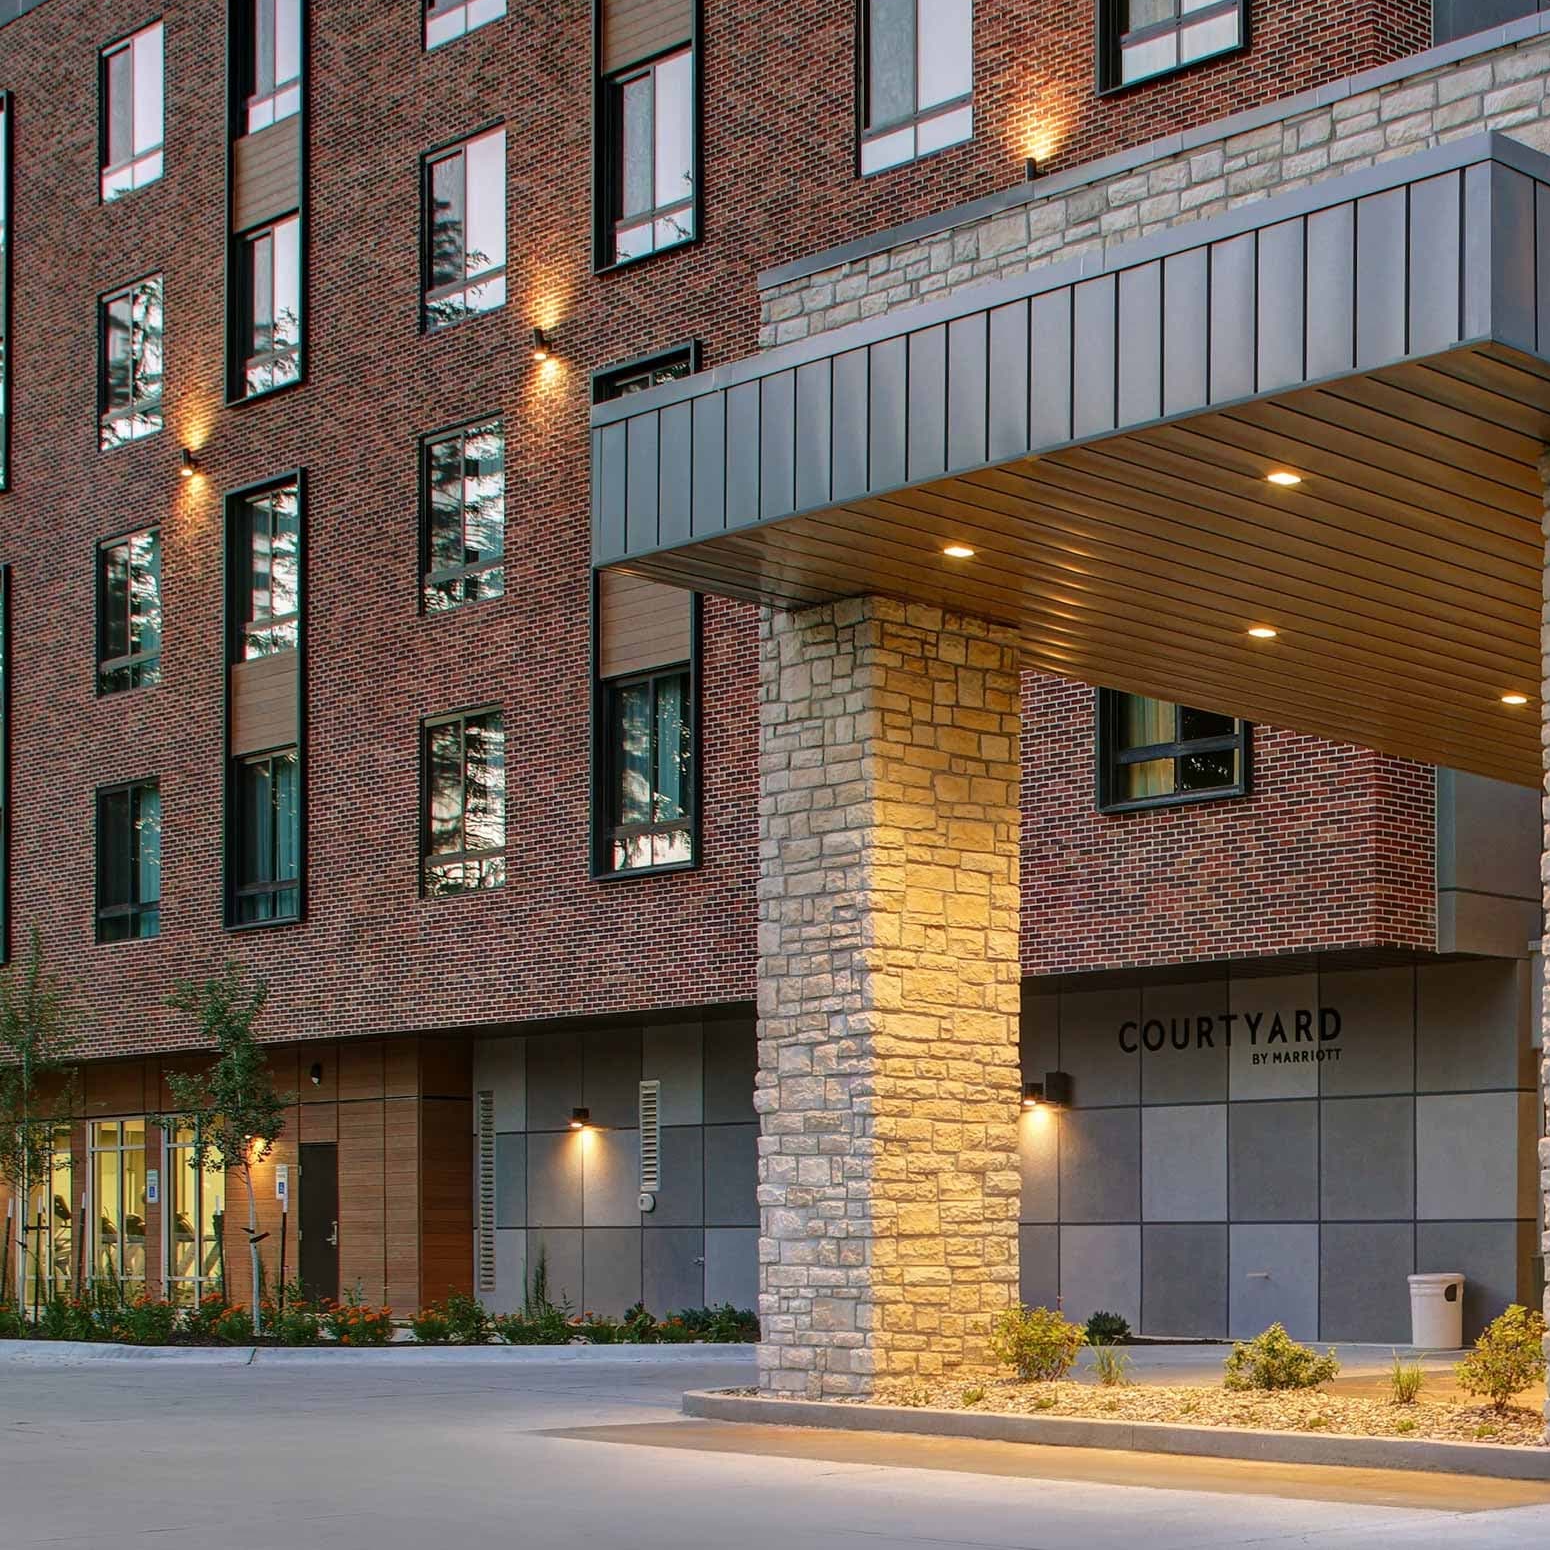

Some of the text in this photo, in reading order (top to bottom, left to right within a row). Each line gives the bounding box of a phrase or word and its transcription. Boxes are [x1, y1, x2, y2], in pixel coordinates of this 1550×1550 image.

[1118, 1007, 1343, 1054] COURTYARD
[1252, 1048, 1343, 1066] BY MARRIOTT
